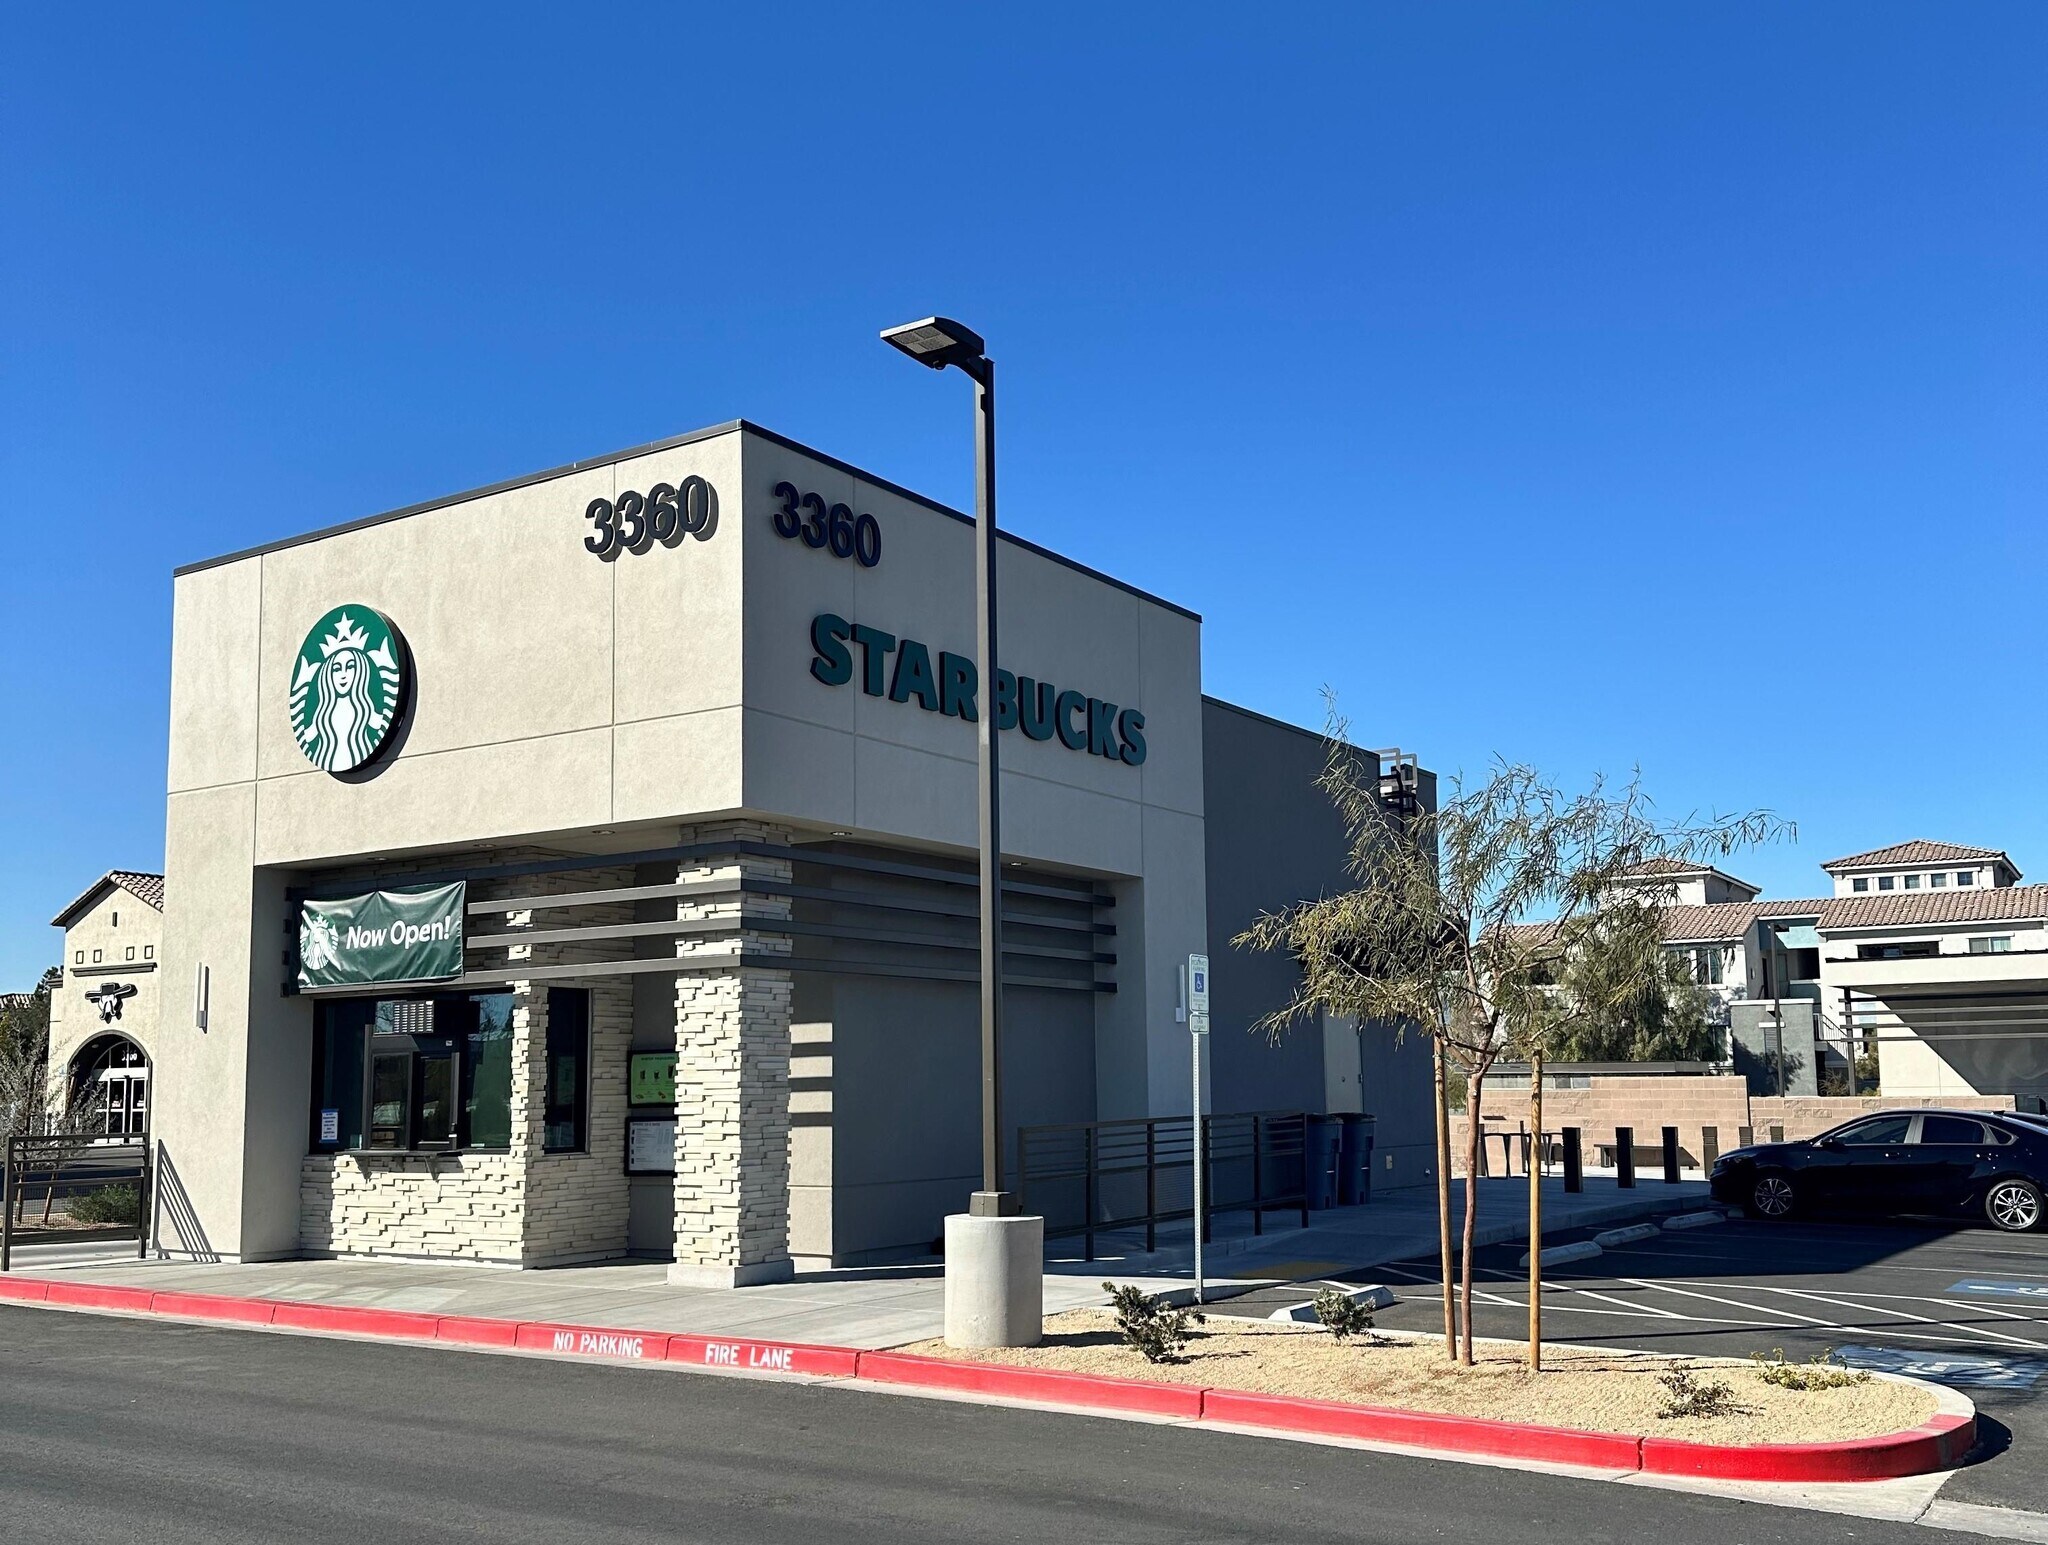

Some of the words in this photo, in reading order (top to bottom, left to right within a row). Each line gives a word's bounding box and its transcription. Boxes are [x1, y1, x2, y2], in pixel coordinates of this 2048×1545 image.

[584, 475, 710, 555] 3360
[772, 480, 882, 568] 3360
[810, 613, 1148, 766] STARBUCKS
[345, 925, 387, 950] Now
[390, 915, 452, 950] Open!
[553, 1332, 574, 1351] NO
[579, 1333, 644, 1358] PARKING
[705, 1343, 740, 1366] FIRE
[749, 1347, 794, 1370] LANE
